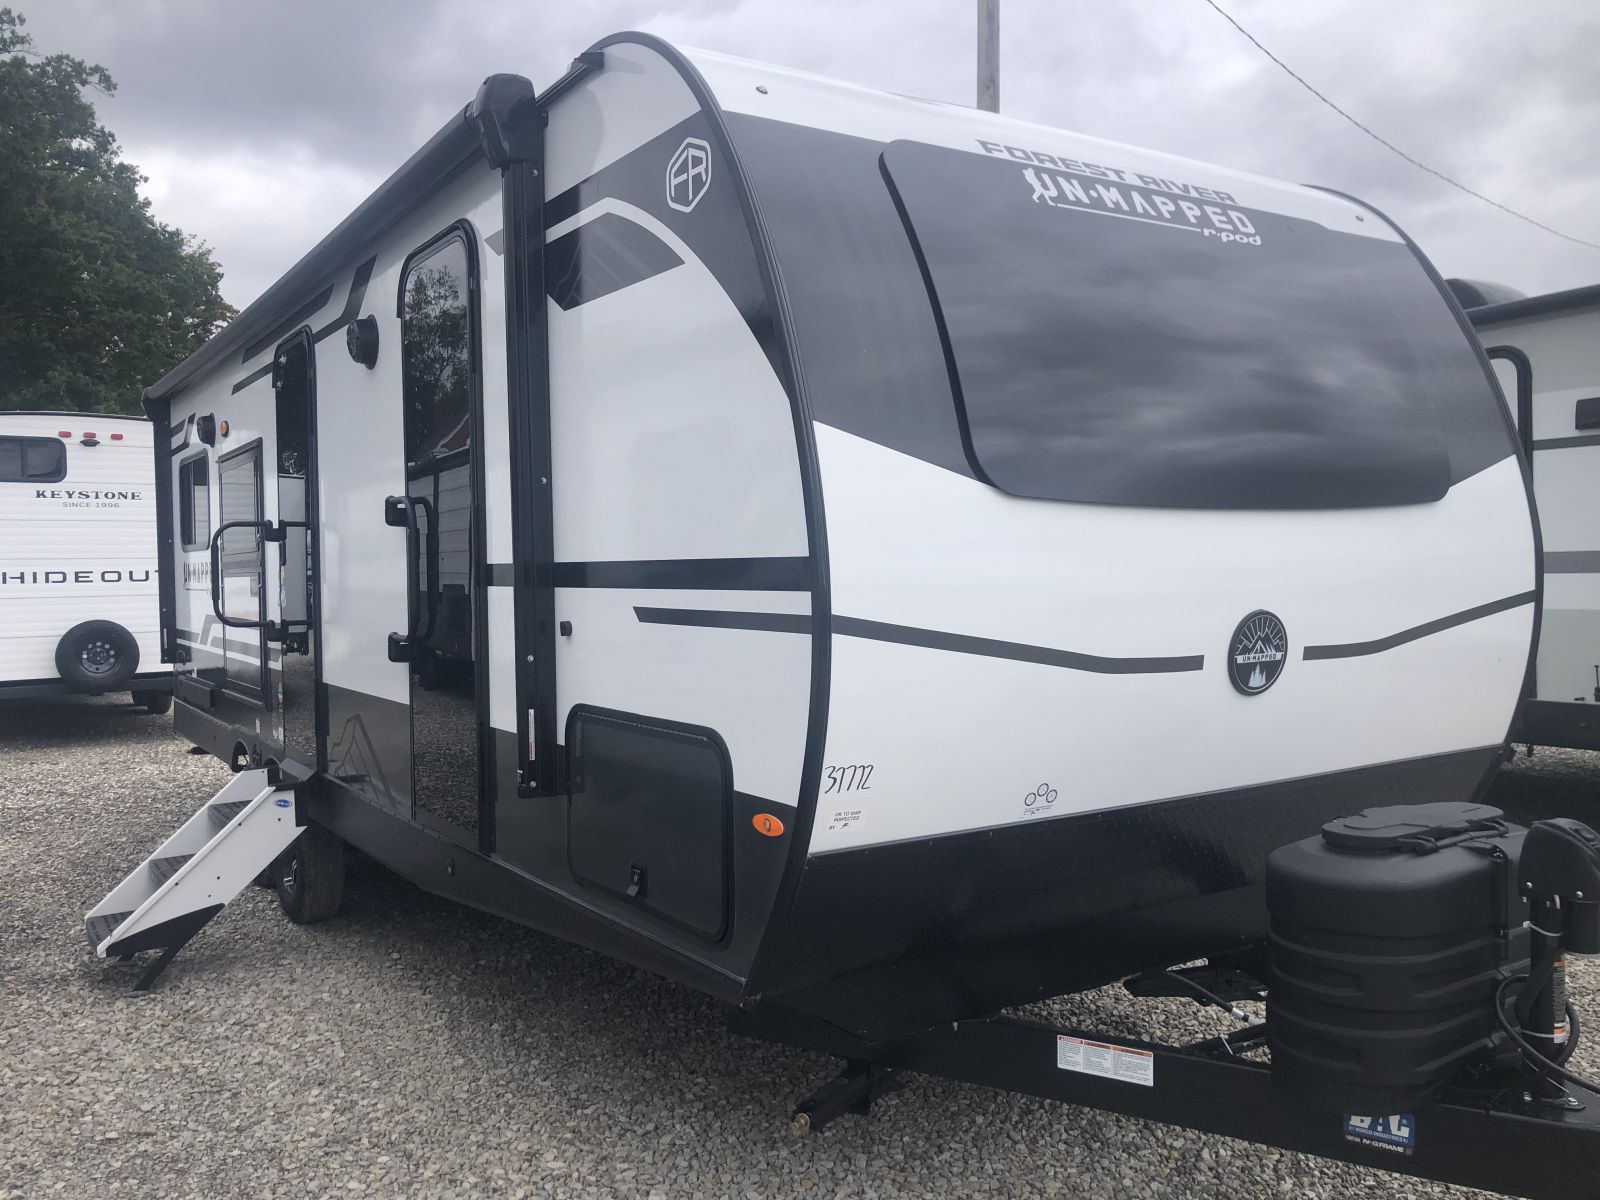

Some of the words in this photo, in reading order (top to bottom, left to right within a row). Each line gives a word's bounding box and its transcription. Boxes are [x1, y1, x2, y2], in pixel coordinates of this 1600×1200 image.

[974, 138, 1128, 182] FOREST
[1132, 172, 1240, 205] RIVER
[35, 489, 142, 501] KEYSTONE
[2, 570, 158, 584] HIDEOU
[1379, 1141, 1404, 1153] FRAME
